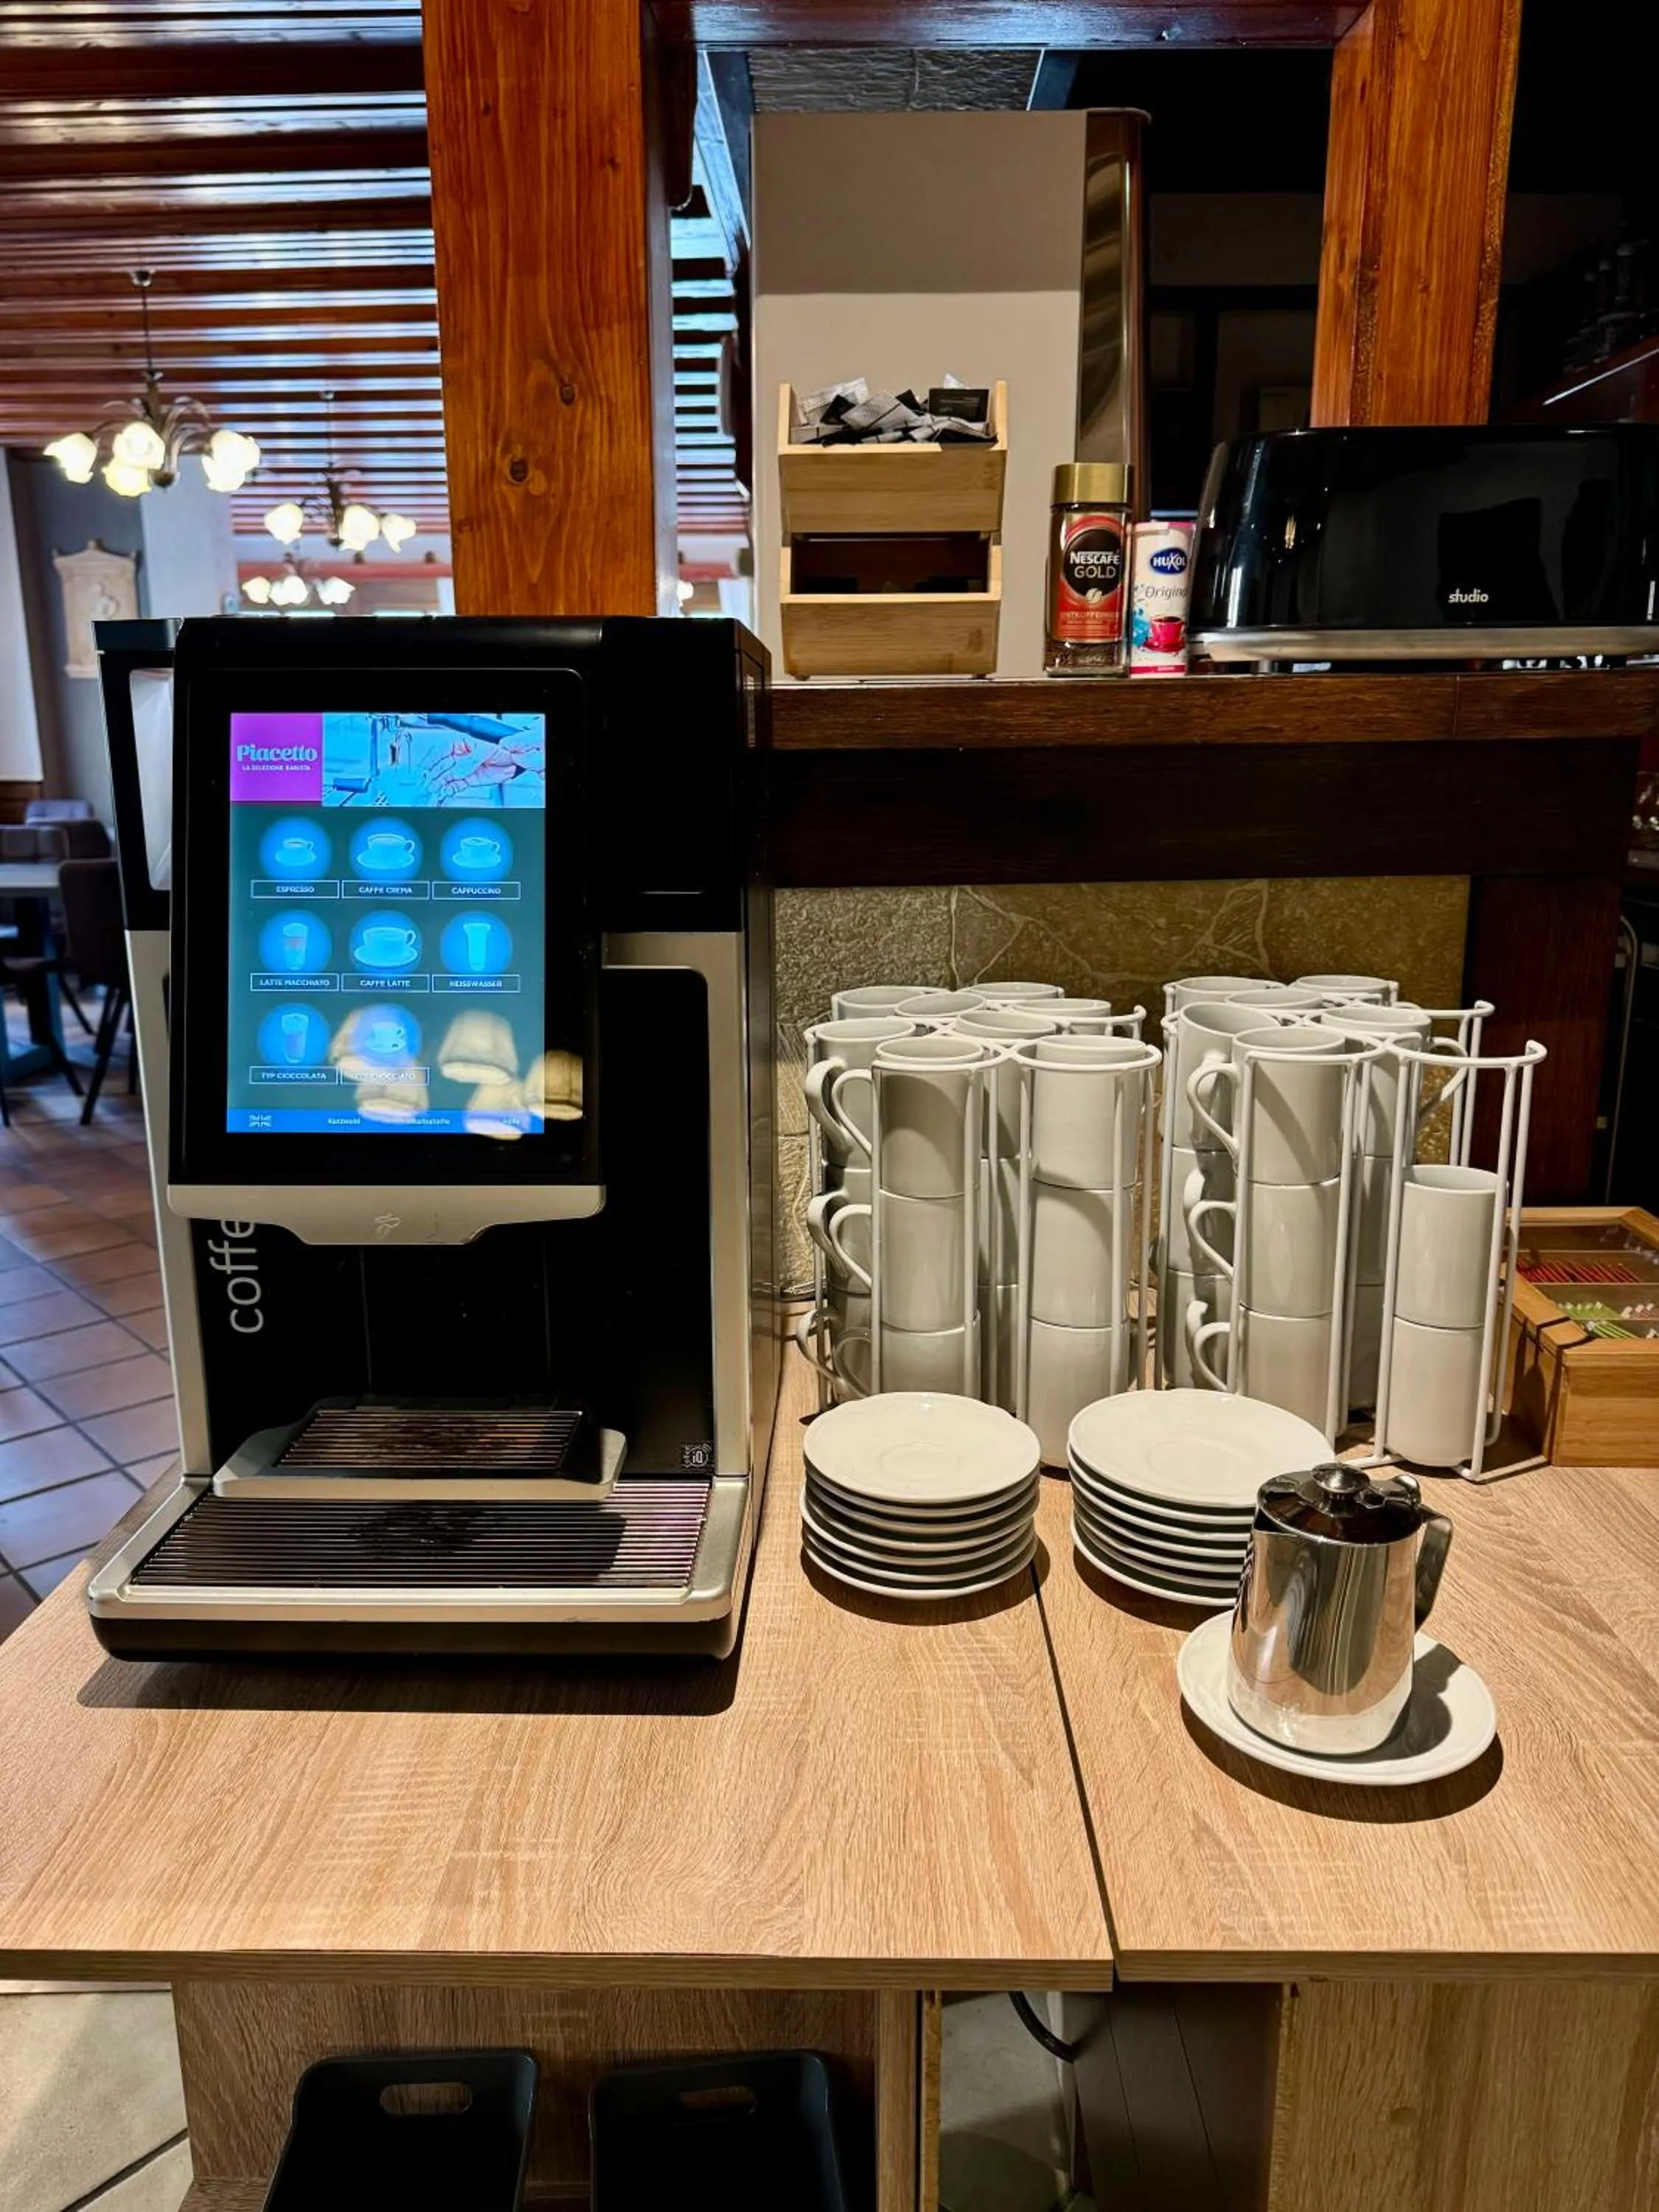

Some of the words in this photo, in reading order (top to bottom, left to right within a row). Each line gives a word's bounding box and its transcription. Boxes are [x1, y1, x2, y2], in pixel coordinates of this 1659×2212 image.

[1074, 566, 1116, 579] GOLD
[1447, 588, 1489, 603] studio
[236, 743, 318, 762] Piacetto
[276, 886, 315, 894] ESPRESSO
[451, 887, 501, 895] CAPPUCCINO
[260, 978, 284, 987] LATTE
[387, 979, 411, 988] LATTE
